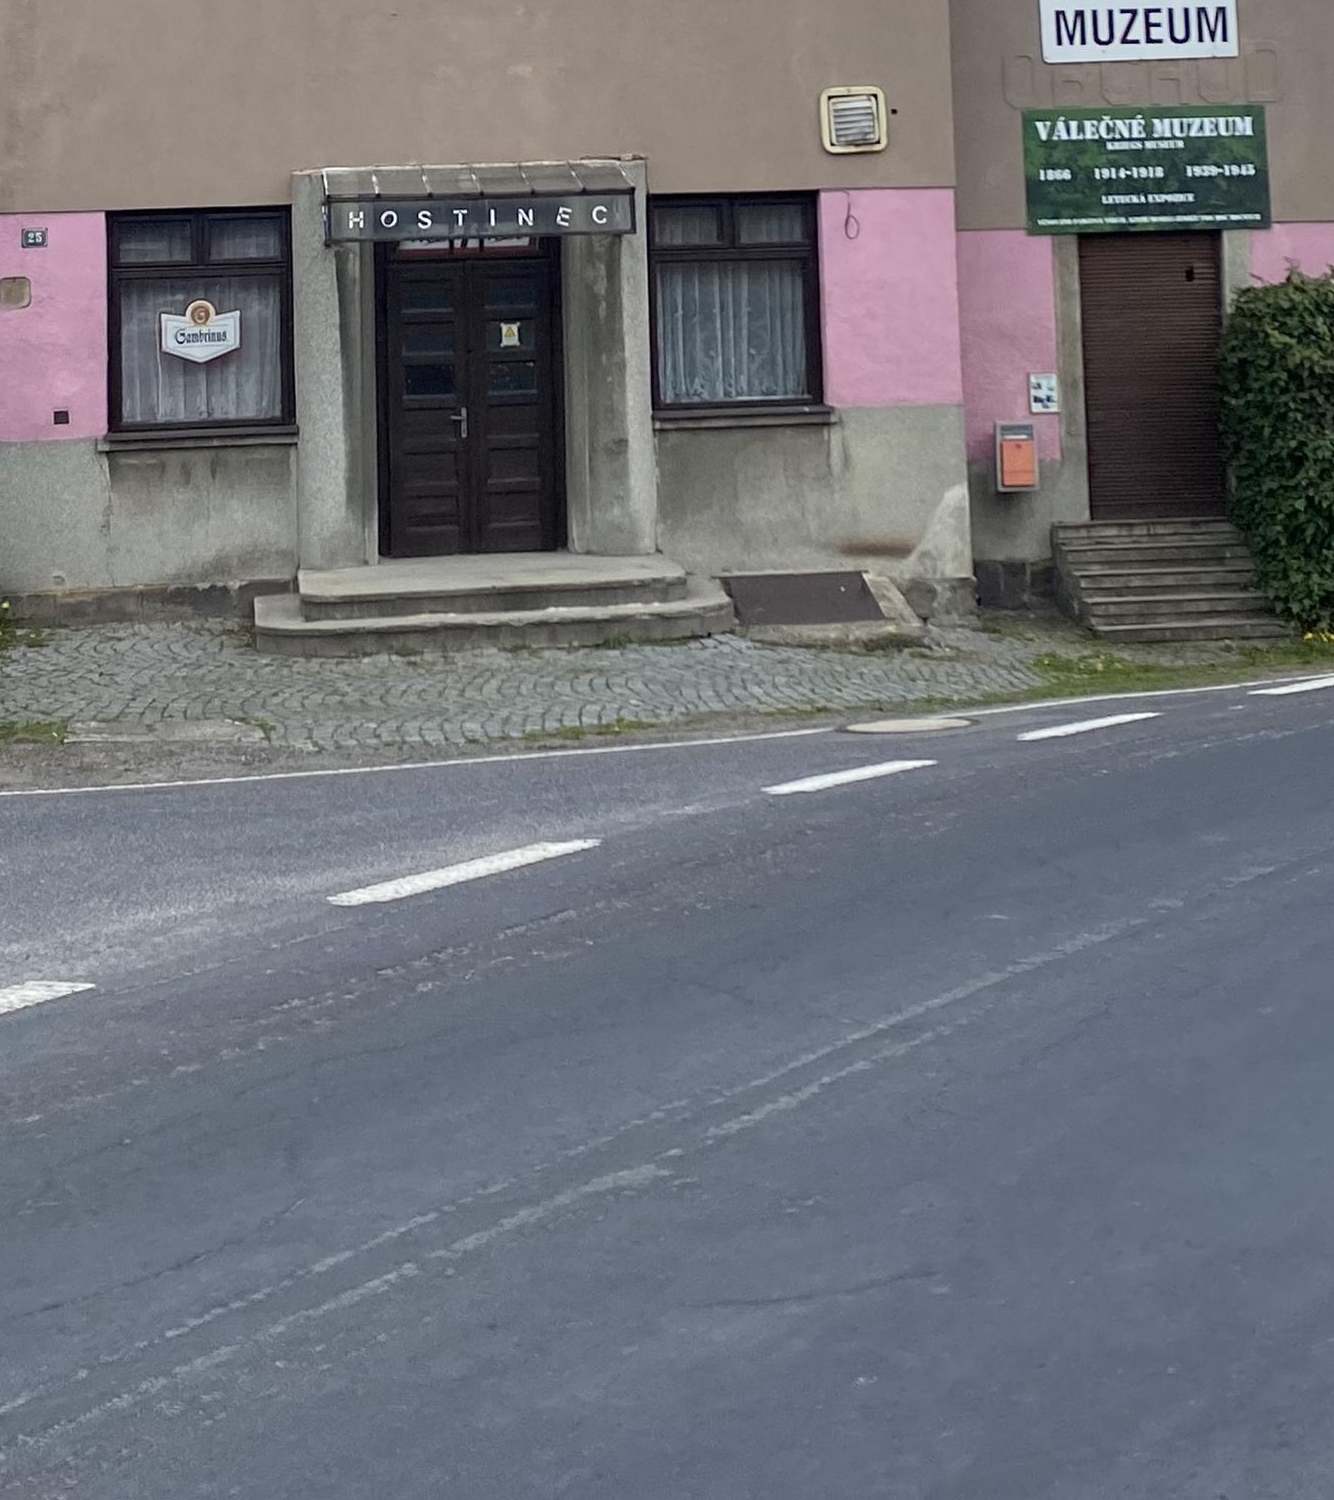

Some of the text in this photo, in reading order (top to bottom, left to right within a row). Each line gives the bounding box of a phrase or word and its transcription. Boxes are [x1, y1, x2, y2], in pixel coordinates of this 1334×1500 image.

[1055, 6, 1228, 46] MUZEUM
[1035, 114, 1254, 141] VÁLEČNÉ MUZEUM
[1094, 166, 1165, 180] 1914-1918
[348, 205, 608, 229] HOSTINEC
[27, 232, 43, 243] 25
[174, 328, 227, 345] Gambrinus
